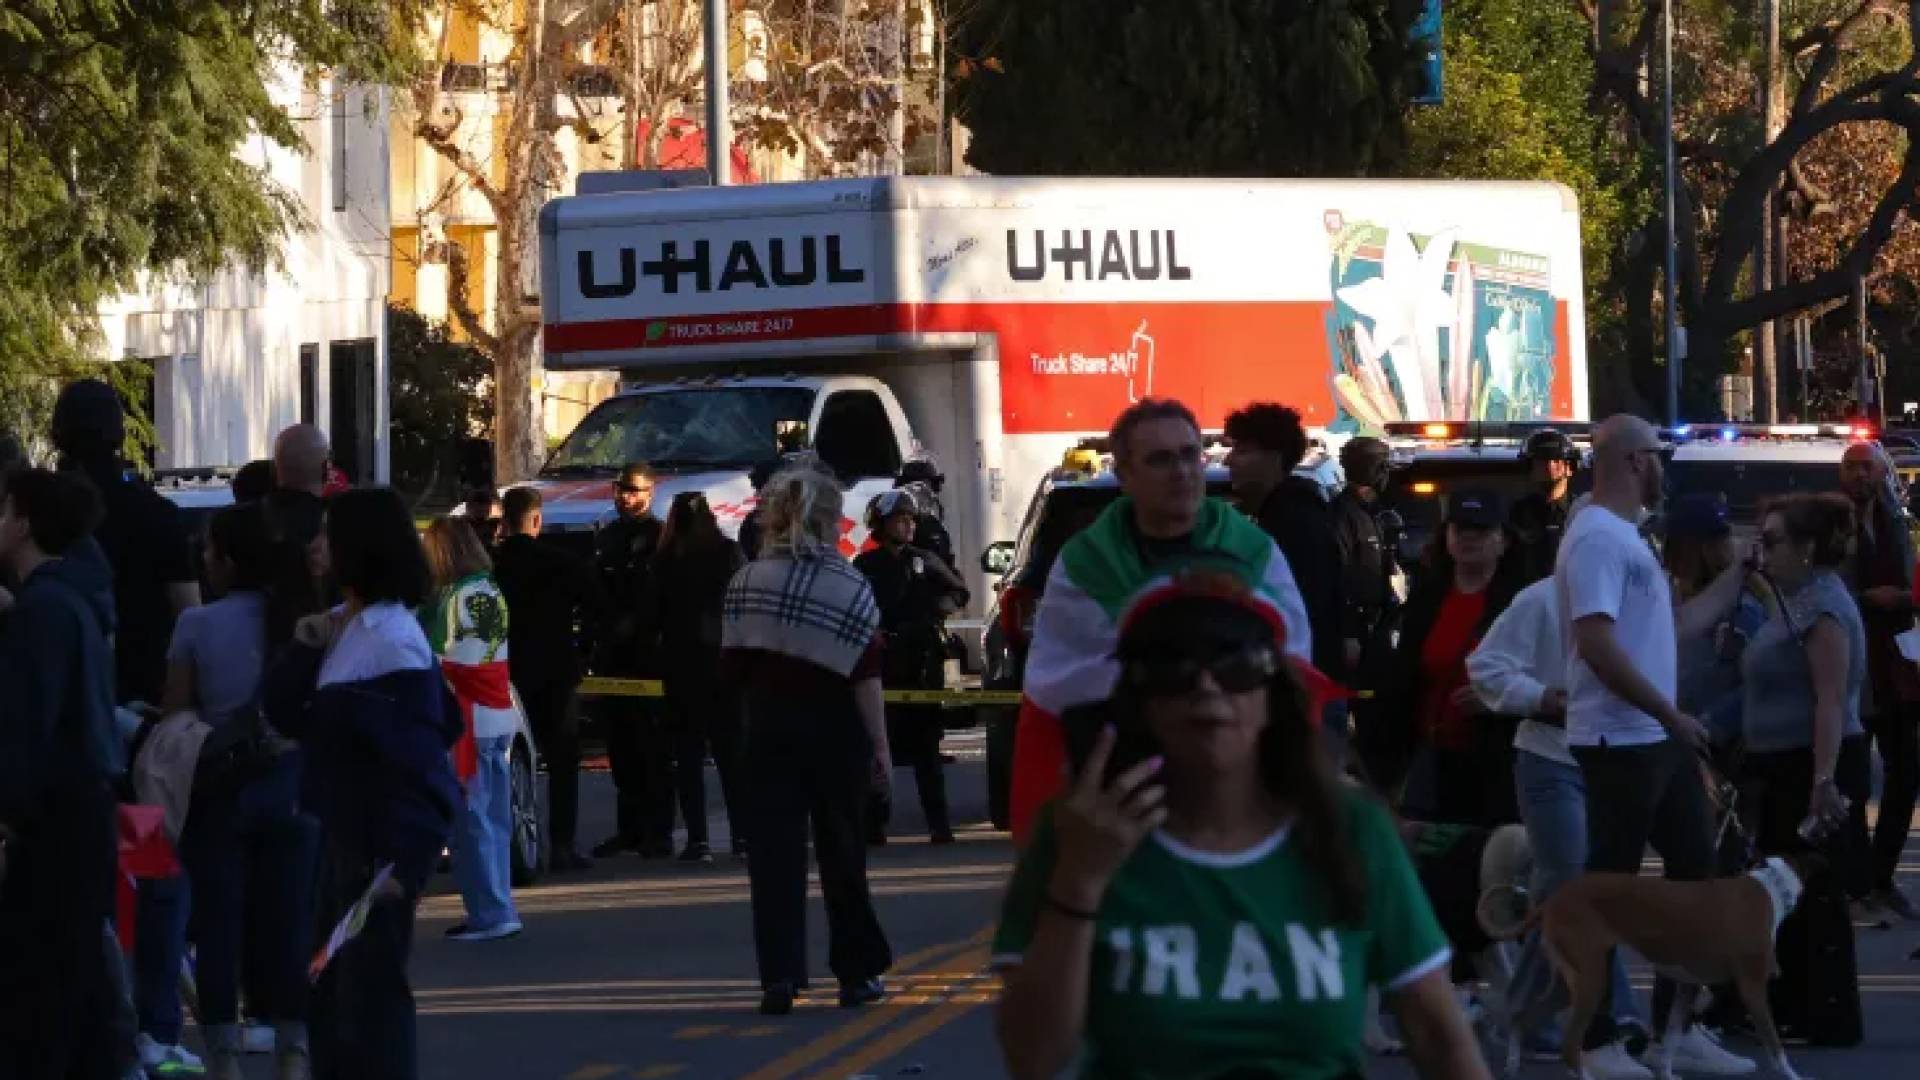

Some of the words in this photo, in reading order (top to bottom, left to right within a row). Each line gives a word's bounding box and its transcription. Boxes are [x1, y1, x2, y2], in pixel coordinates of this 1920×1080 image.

[577, 235, 865, 299] U-HAUL
[1006, 228, 1192, 281] U-HAUL
[669, 323, 714, 338] TRUCK
[716, 319, 760, 335] SHARE
[763, 317, 794, 333] 24/7
[1030, 352, 1068, 375] Truck
[1069, 352, 1107, 375] Share
[1108, 350, 1139, 376] 24/7
[1107, 921, 1346, 1000] IRAN
